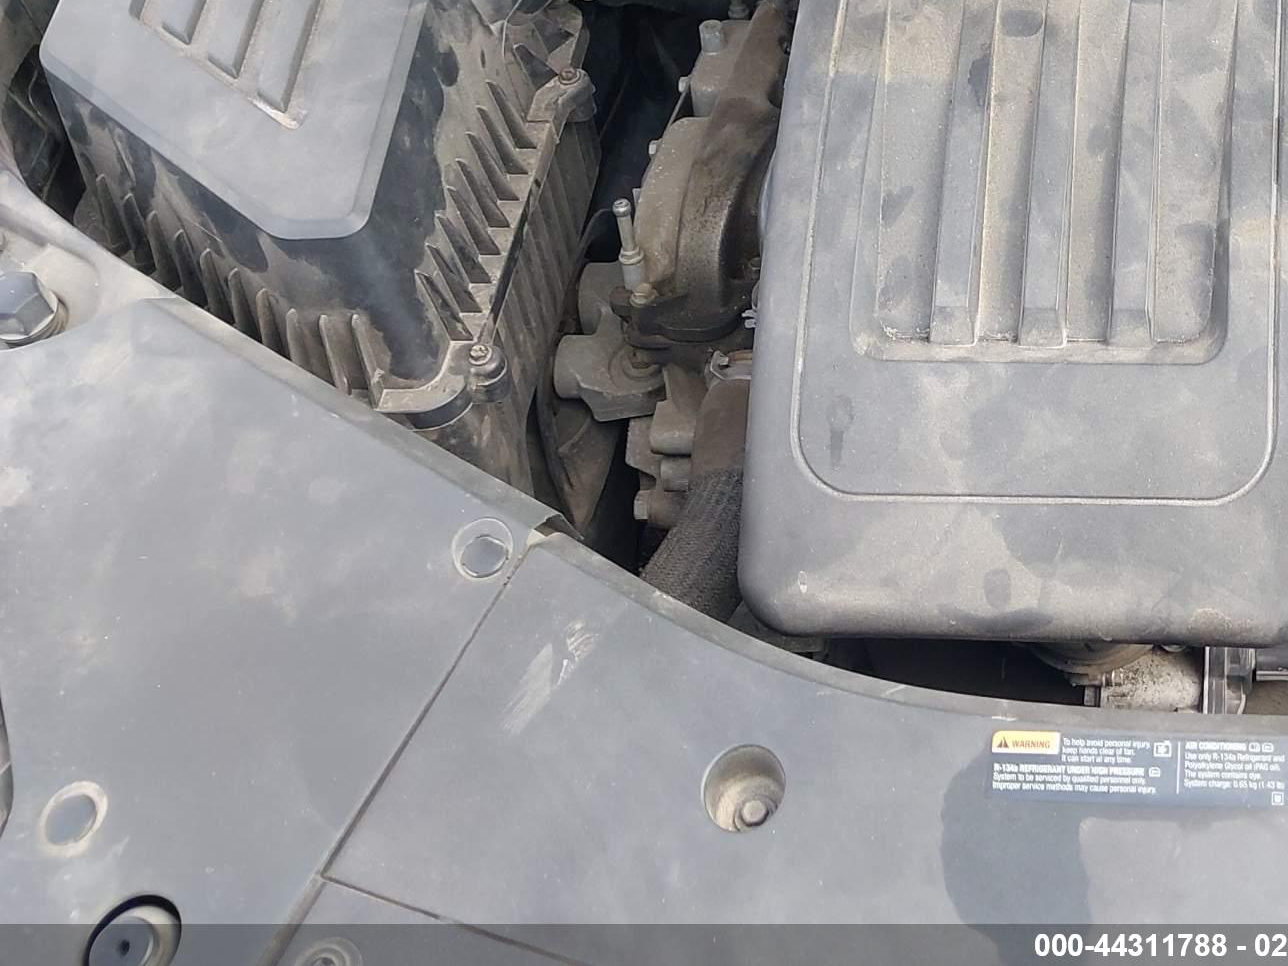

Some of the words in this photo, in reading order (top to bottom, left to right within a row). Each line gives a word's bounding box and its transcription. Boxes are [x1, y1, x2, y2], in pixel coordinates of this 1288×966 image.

[1011, 739, 1050, 749] WARNING
[1063, 737, 1070, 746] To
[1071, 738, 1085, 747] help
[1086, 738, 1103, 747] avoid
[1104, 739, 1132, 749] personal
[1185, 741, 1197, 750] AIR
[994, 763, 1018, 773] R-134a
[1019, 764, 1065, 774] REFRIGERANT
[1067, 765, 1090, 774] UNDER
[1091, 766, 1108, 775] HIGH
[1109, 766, 1145, 776] PRESSURE
